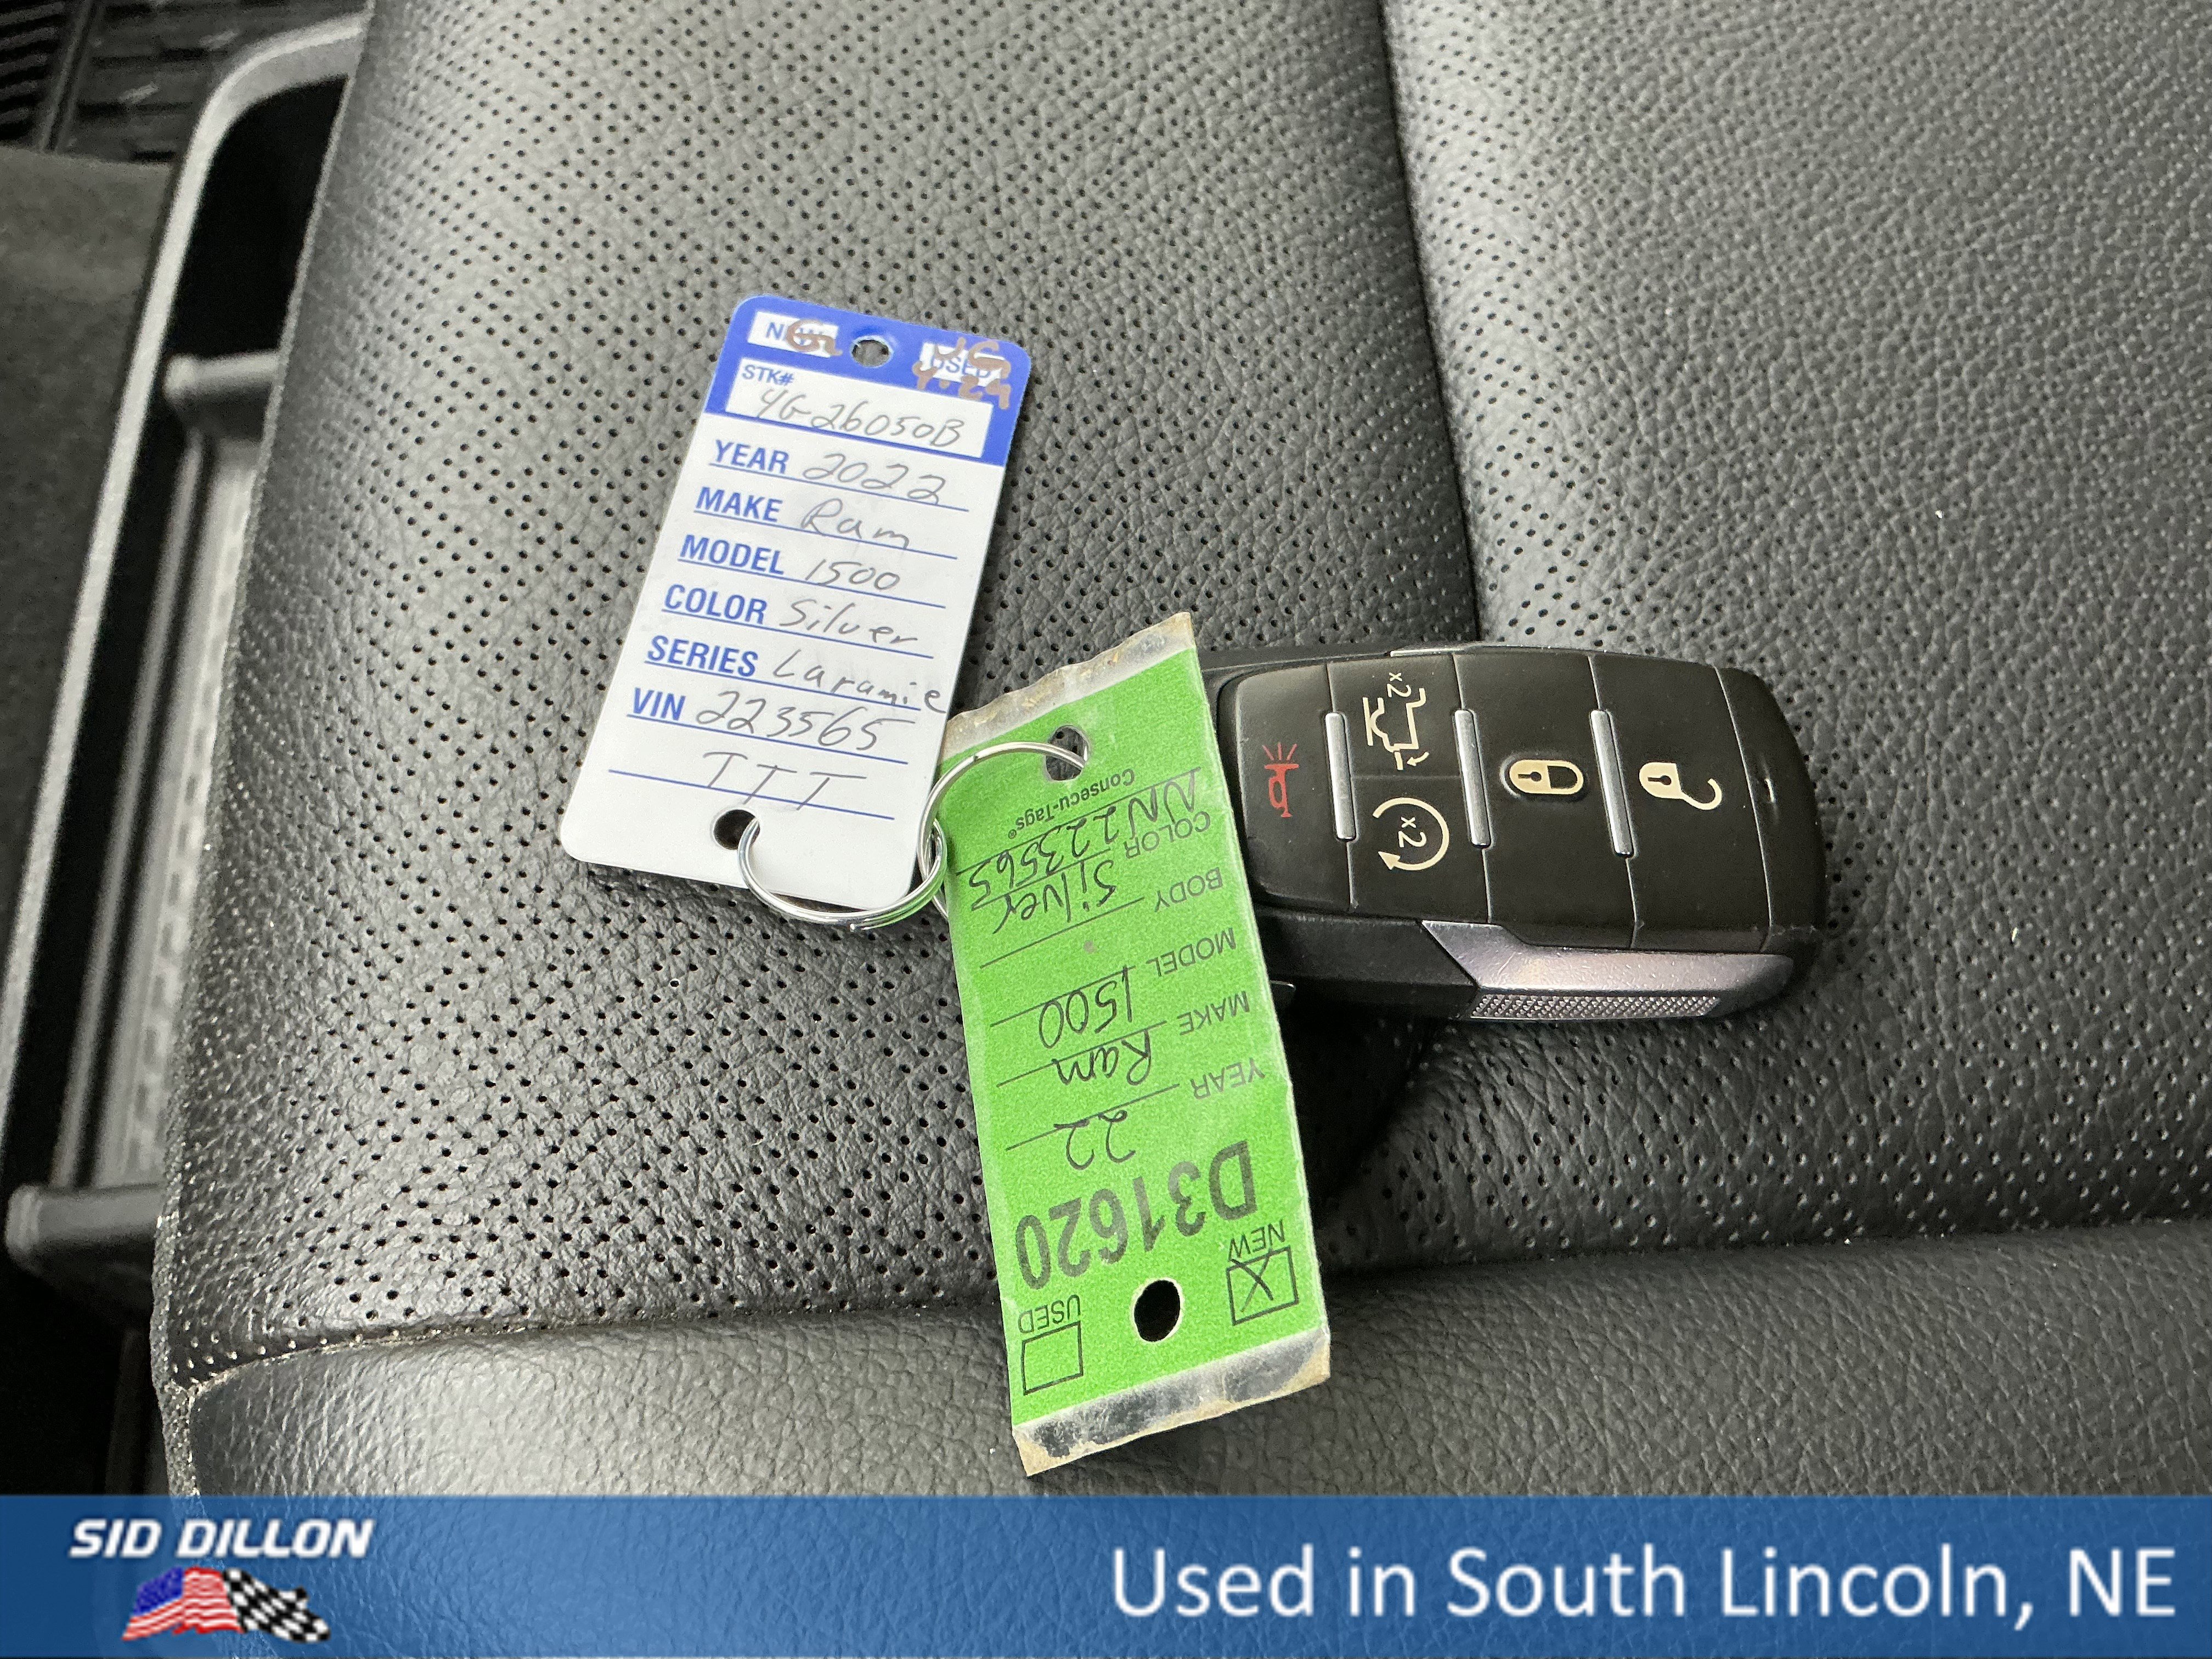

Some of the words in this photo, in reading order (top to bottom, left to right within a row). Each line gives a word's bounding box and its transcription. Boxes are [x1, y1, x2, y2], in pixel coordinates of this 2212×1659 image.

[742, 364, 795, 386] STK#
[715, 439, 789, 475] YEAR
[803, 453, 946, 506] 2022
[696, 486, 783, 523] MAKE
[800, 498, 909, 549] Ram
[680, 534, 785, 575] MODEL
[805, 558, 900, 590] 1500
[664, 584, 768, 625] COLOR
[780, 598, 917, 645] Silver
[647, 635, 759, 678] SERIES
[773, 648, 947, 713] Laramie
[632, 687, 686, 721] VIN
[696, 690, 916, 751] 223565
[1124, 810, 1211, 860] COLOR
[994, 860, 1116, 934] Silver
[1154, 867, 1224, 912] BODY
[1146, 927, 1236, 977] MODEL
[1039, 965, 1133, 1048] 1500
[1177, 991, 1250, 1036] MAKE
[1051, 1028, 1152, 1086] Ram
[1190, 1057, 1265, 1099] YEAR
[1053, 1109, 1136, 1171] 22
[1015, 1141, 1256, 1290] D31620
[1228, 1219, 1286, 1261] NEW
[1017, 1294, 1081, 1334] USED
